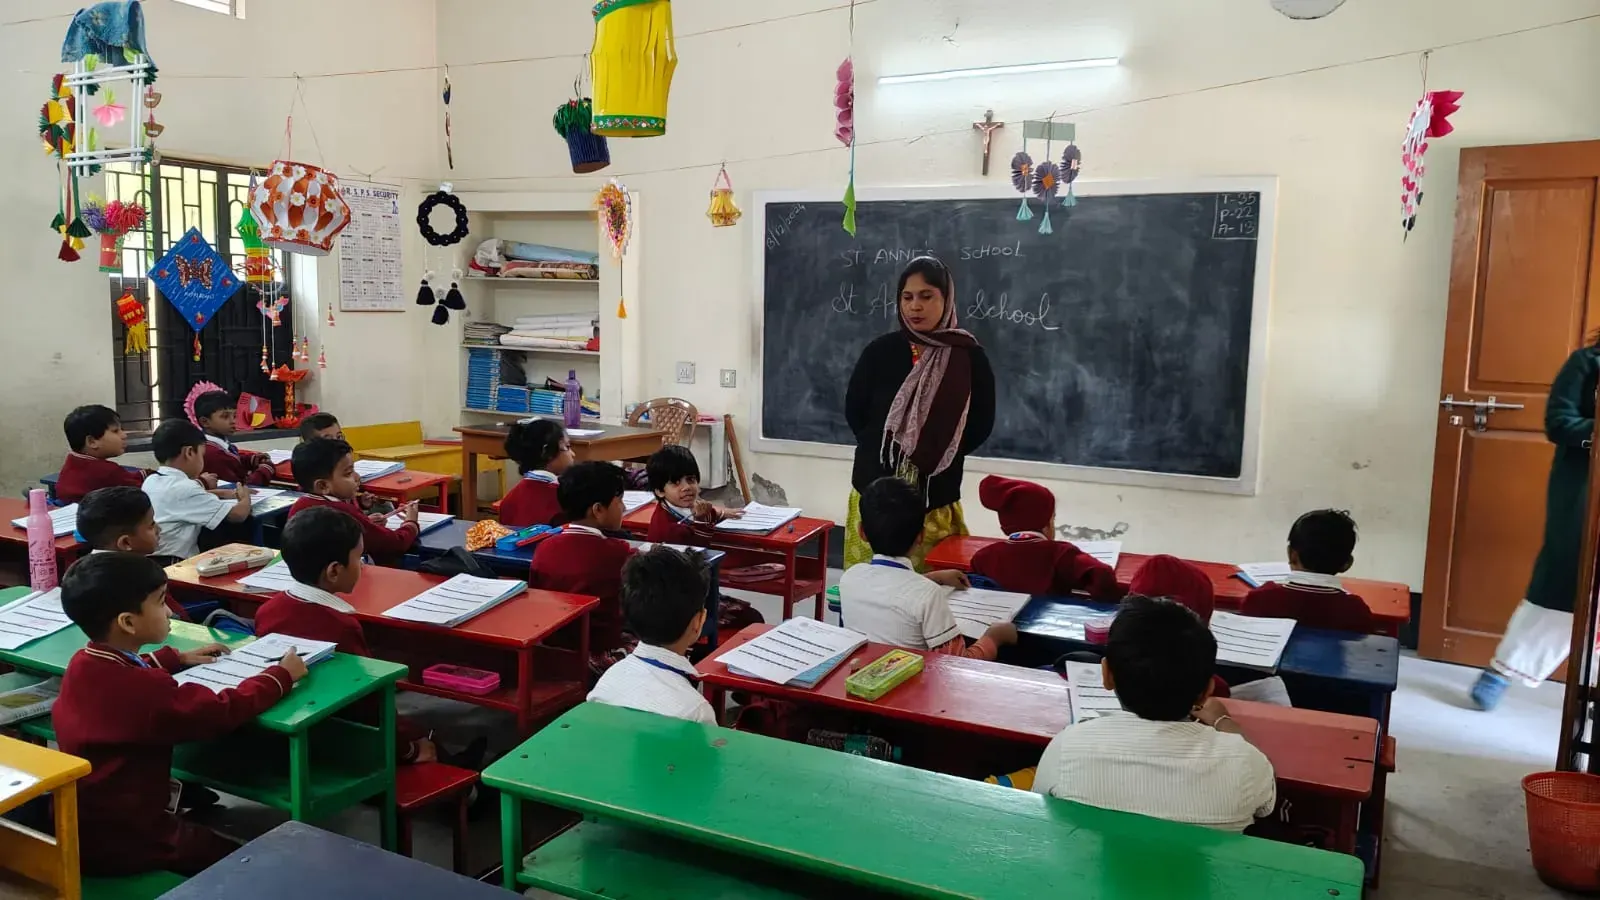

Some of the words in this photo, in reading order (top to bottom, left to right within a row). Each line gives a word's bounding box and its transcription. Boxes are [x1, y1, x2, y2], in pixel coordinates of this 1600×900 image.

[373, 190, 399, 200] SECURITY
[960, 240, 1026, 260] SCHOOL
[965, 289, 1060, 331] School
